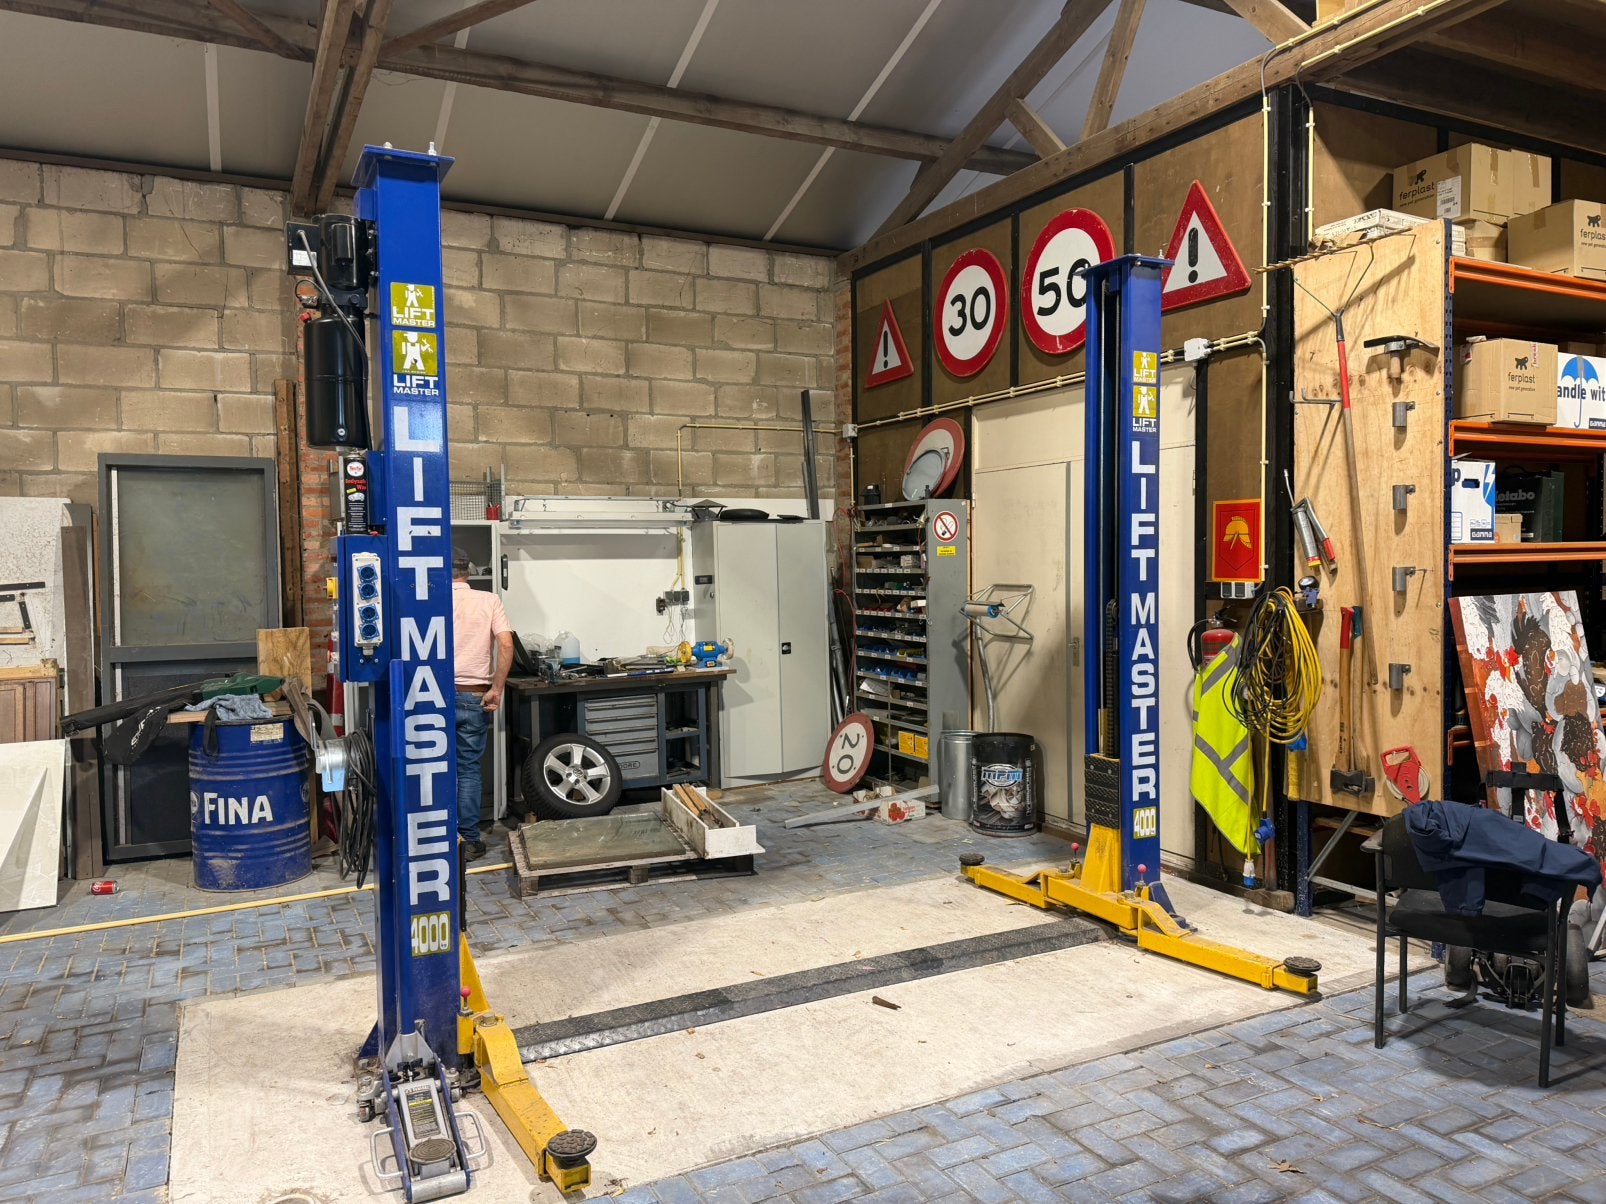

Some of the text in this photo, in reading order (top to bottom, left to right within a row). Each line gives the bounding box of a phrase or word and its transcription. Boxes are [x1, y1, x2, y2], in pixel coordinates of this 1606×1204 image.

[1399, 181, 1435, 201] ferplast
[1580, 228, 1606, 241] ferplas
[1037, 258, 1091, 317] 50
[392, 306, 435, 320] LIFT
[948, 286, 991, 337] 30
[392, 317, 436, 327] MASTER
[393, 374, 439, 389] LIFT
[1133, 369, 1156, 378] LIFT
[1507, 372, 1536, 384] ferplast
[393, 386, 440, 396] MASTER
[1557, 384, 1606, 402] andle wit
[1132, 418, 1157, 427] LIFT
[393, 406, 444, 601] LIFT
[1496, 489, 1536, 502] etabo
[1131, 441, 1156, 582] LIFT
[1130, 592, 1157, 802] MASTER
[400, 616, 451, 906] MASTER
[836, 733, 860, 775] 20
[203, 792, 274, 825] FINA
[1133, 807, 1156, 839] 4000
[411, 913, 449, 954] 4000
